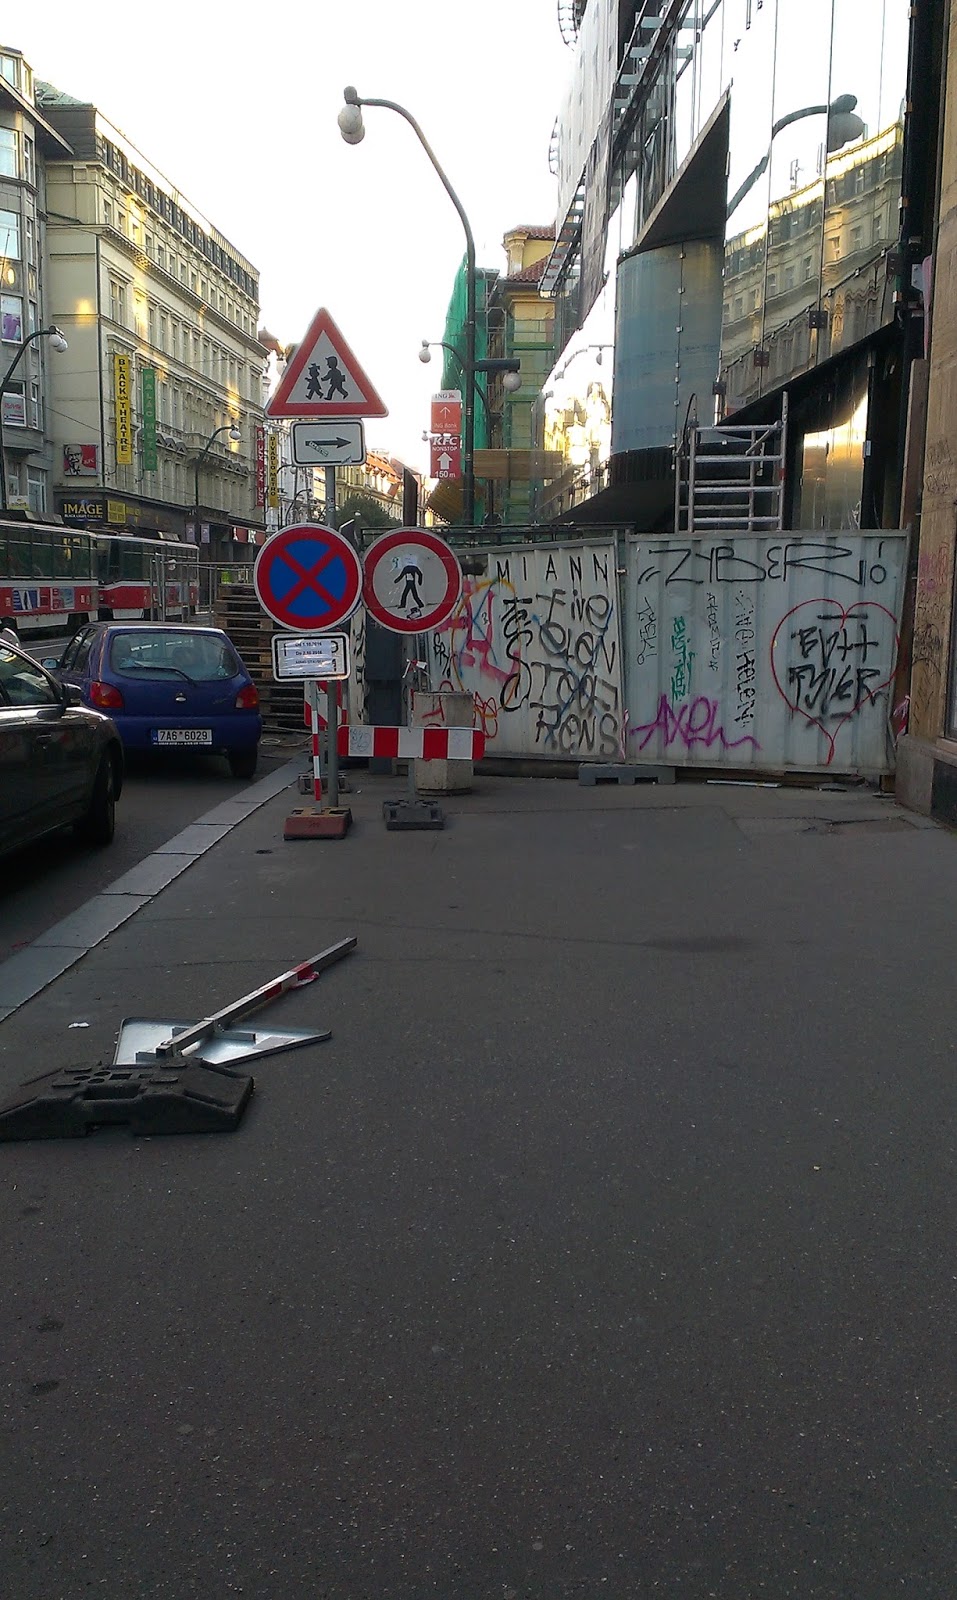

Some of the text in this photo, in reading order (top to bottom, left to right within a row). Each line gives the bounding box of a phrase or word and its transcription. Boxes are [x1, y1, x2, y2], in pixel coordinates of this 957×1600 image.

[118, 358, 126, 395] BLACK
[119, 402, 128, 452] THEATRE
[433, 436, 458, 446] KFC
[434, 470, 449, 478] 150
[269, 472, 277, 497] METRO
[63, 503, 103, 515] IMAGE
[160, 730, 178, 741] 7A6
[184, 730, 208, 741] 6029
